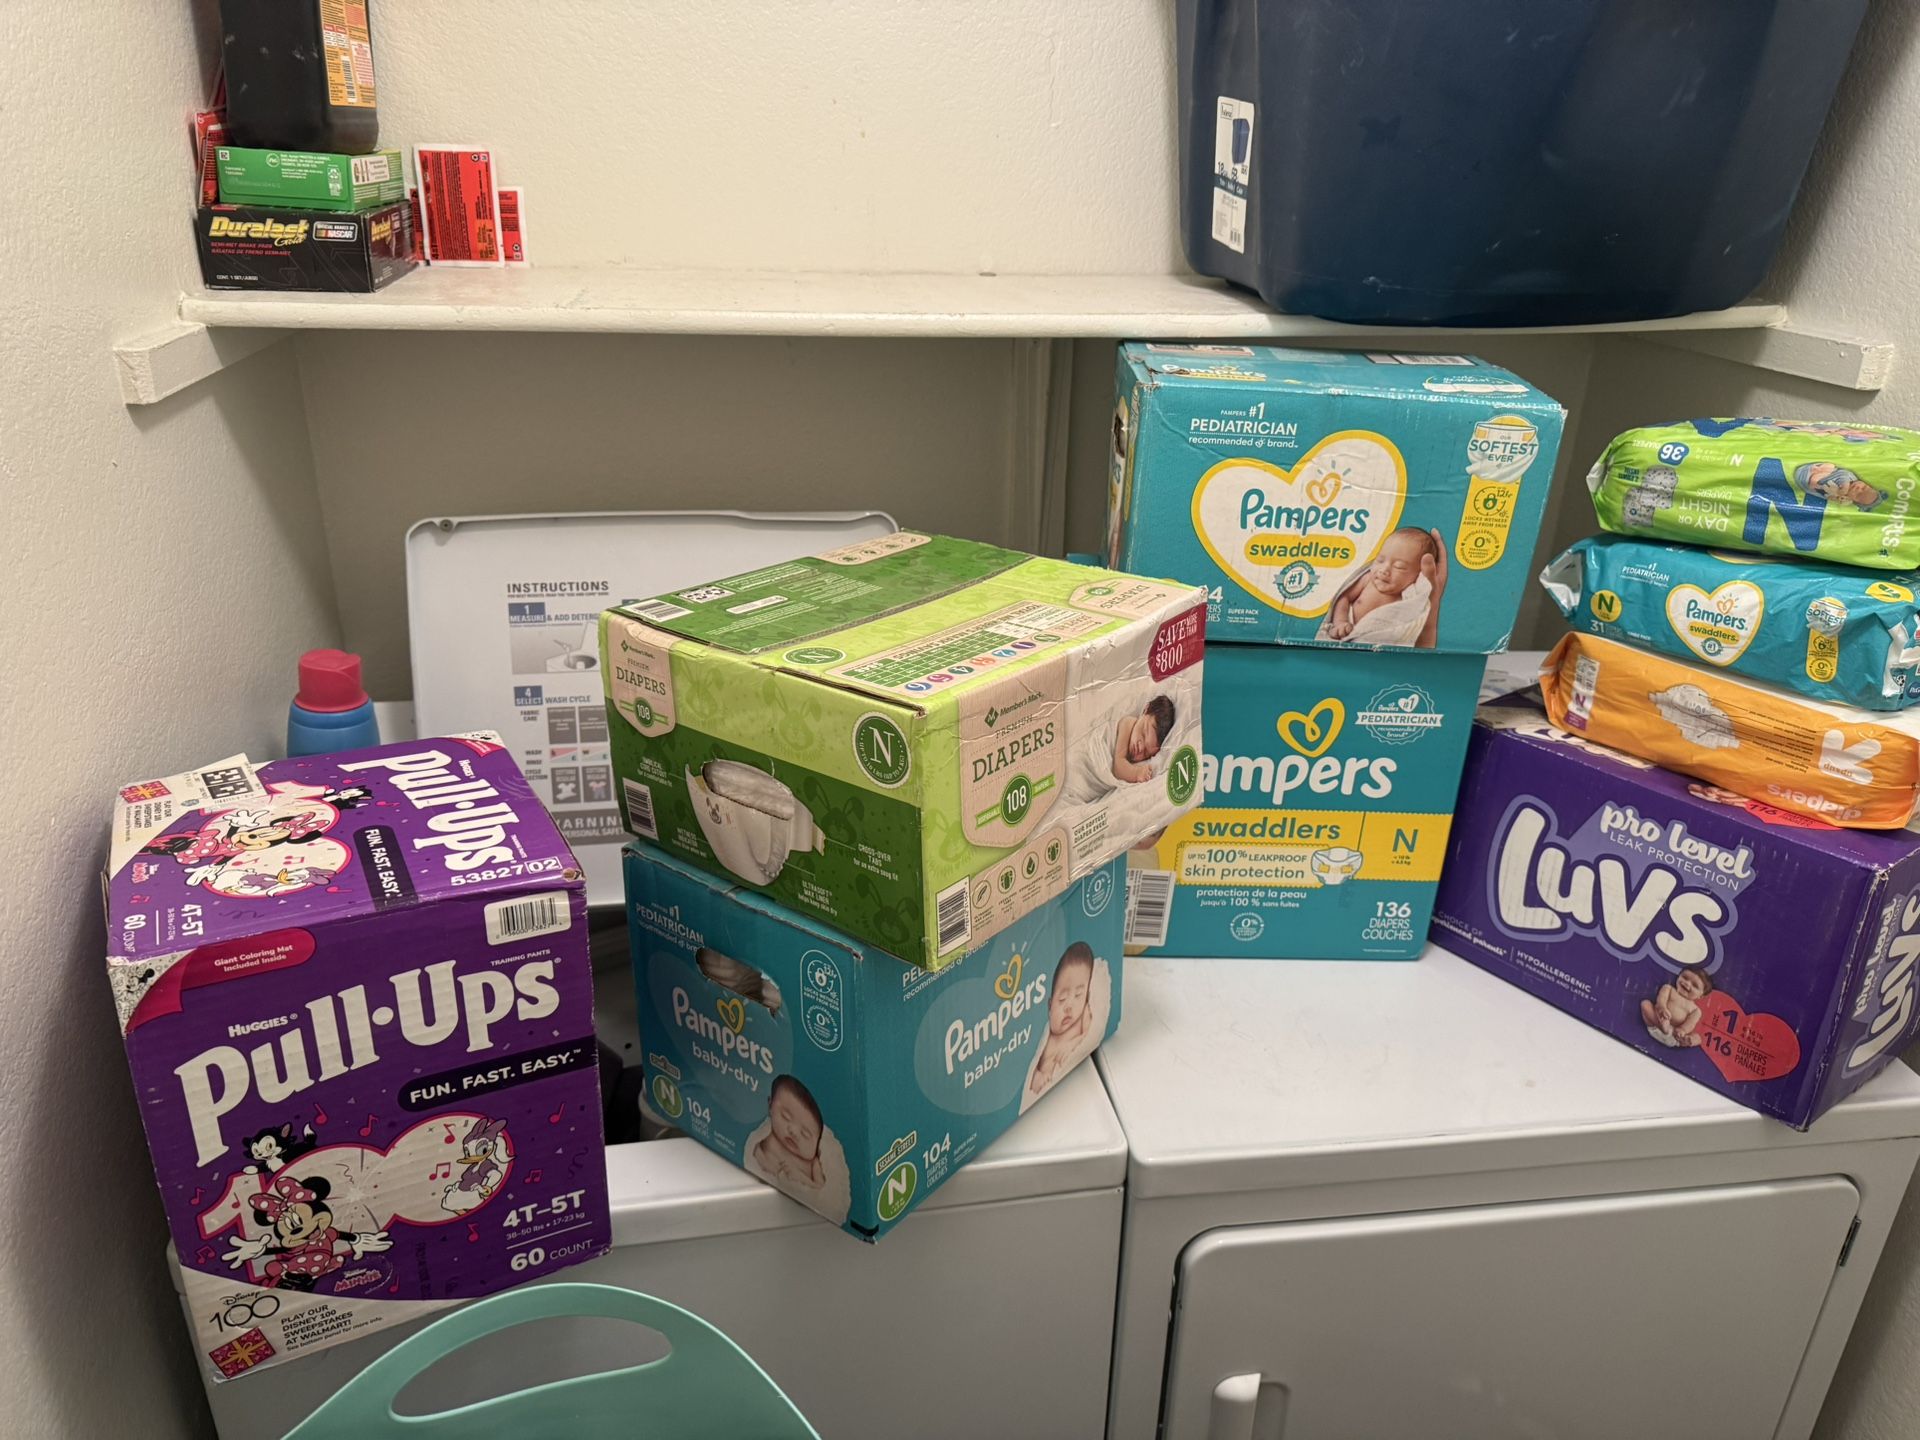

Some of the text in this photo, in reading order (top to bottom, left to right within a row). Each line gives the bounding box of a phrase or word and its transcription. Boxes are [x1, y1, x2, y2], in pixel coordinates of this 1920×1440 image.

[209, 216, 309, 238] Duralast
[328, 230, 353, 238] NASCAR
[274, 236, 304, 247] Gold
[1249, 402, 1265, 420] #1
[1190, 418, 1298, 436] PEDIATRICIAN
[1188, 435, 1253, 448] recommended
[1469, 440, 1537, 455] SOFTEST
[1661, 444, 1685, 461] 36
[1488, 454, 1514, 463] EVER
[1730, 454, 1744, 467] N
[1697, 489, 1732, 499] DIAPERS
[1743, 457, 1828, 551] N
[1240, 488, 1369, 536] Pampers
[1679, 498, 1730, 515] NIGHT
[1678, 515, 1729, 532] DAY OR
[1249, 541, 1349, 560] swaddlers
[1474, 537, 1491, 548] 0%
[1288, 571, 1303, 586] #1
[1622, 566, 1669, 581] PEDIATRICIAN
[507, 581, 609, 593] INSTRUCTIONS
[1099, 584, 1151, 609] DIAPERS
[524, 605, 530, 614] 1
[1598, 593, 1614, 612] N
[510, 615, 545, 623] MEASURE
[1591, 620, 1604, 632] 31
[1686, 600, 1746, 630] Pampers
[1807, 609, 1845, 623] SOFTEST
[1157, 618, 1187, 652] SAVE
[1186, 624, 1197, 636] THAN
[1689, 624, 1737, 642] swaddlers
[1156, 643, 1183, 672] $800
[1707, 642, 1716, 651] #1
[616, 666, 666, 695] DIAPERS
[516, 697, 541, 705] SELECT
[569, 695, 590, 703] CYCLE
[1000, 691, 1043, 716] Member's Mark
[1575, 693, 1586, 708] N
[637, 704, 650, 720] 108
[1361, 714, 1437, 724] PEDIATRICIAN
[869, 726, 895, 767] N
[973, 722, 1054, 783] DIAPERS
[1177, 755, 1190, 789] N
[1202, 754, 1397, 805] ampers
[1007, 785, 1027, 814] 108
[1767, 783, 1862, 819] diapers
[364, 828, 381, 849] FUN.
[1192, 817, 1341, 840] swaddlers
[1392, 828, 1419, 853] N
[1601, 805, 1751, 879] pro level
[370, 850, 389, 874] FAST.
[858, 843, 891, 862] CROSS-OVER
[868, 855, 882, 867] TABS
[1206, 849, 1247, 863] 100%
[1248, 854, 1307, 863] LEAKPROOF
[1609, 831, 1740, 891] LEAK PROTECTION
[451, 859, 561, 886] 53827 02
[1185, 865, 1304, 880] skin protection
[1196, 888, 1307, 900] protection de la peau
[1230, 898, 1248, 906] 100
[1251, 898, 1260, 906] %
[1280, 900, 1300, 908] fuites
[181, 904, 203, 936] 4T-5T
[669, 905, 679, 920] #1
[1376, 901, 1411, 918] 136
[123, 914, 146, 952] 60 COUNT
[636, 902, 704, 944] PEDIATRICIAN
[1241, 918, 1258, 928] 0%
[1362, 928, 1413, 940] COUCHES
[1369, 917, 1410, 929] DIAPERS
[1438, 911, 1483, 936] CHOICE OF
[214, 944, 293, 968] Giant Coloring Mat
[223, 953, 287, 973] Included Inside
[490, 948, 551, 967] TRAINING PANTS
[1517, 950, 1592, 992] HYPOALLERGENIC
[1525, 964, 1569, 990] PARABENS AND
[228, 1014, 289, 1038] HUGGIES
[672, 987, 773, 1074] Pampers
[944, 972, 1047, 1075] Pampers
[1723, 1010, 1738, 1034] 1
[1704, 1032, 1731, 1056] 116
[1737, 1044, 1767, 1065] DIAPERS
[693, 1041, 759, 1092] baby-dry
[964, 1024, 1032, 1089] baby-dry
[410, 1082, 457, 1104] FUN.
[462, 1066, 516, 1091] FAST.
[660, 1079, 676, 1105] N
[686, 1097, 711, 1123] 104
[879, 1136, 915, 1170] SESAME STREET
[923, 1132, 951, 1169] 104
[888, 1167, 907, 1206] N
[503, 1189, 586, 1228] 4T-5T
[533, 1222, 545, 1231] lbs
[553, 1214, 574, 1227] 17-23
[576, 1211, 585, 1221] kg
[510, 1239, 593, 1271] 60 COUNT
[220, 1291, 260, 1306] Disney
[209, 1295, 280, 1333] 100
[281, 1304, 328, 1325] PLAY OUR
[282, 1309, 336, 1332] DISNEY 100
[284, 1311, 353, 1338] SWEEPSTAKES
[285, 1319, 352, 1346] AT WALMART!
[300, 1338, 323, 1347] bottom
[324, 1331, 342, 1341] panel
[343, 1326, 351, 1334] for
[352, 1322, 368, 1330] more
